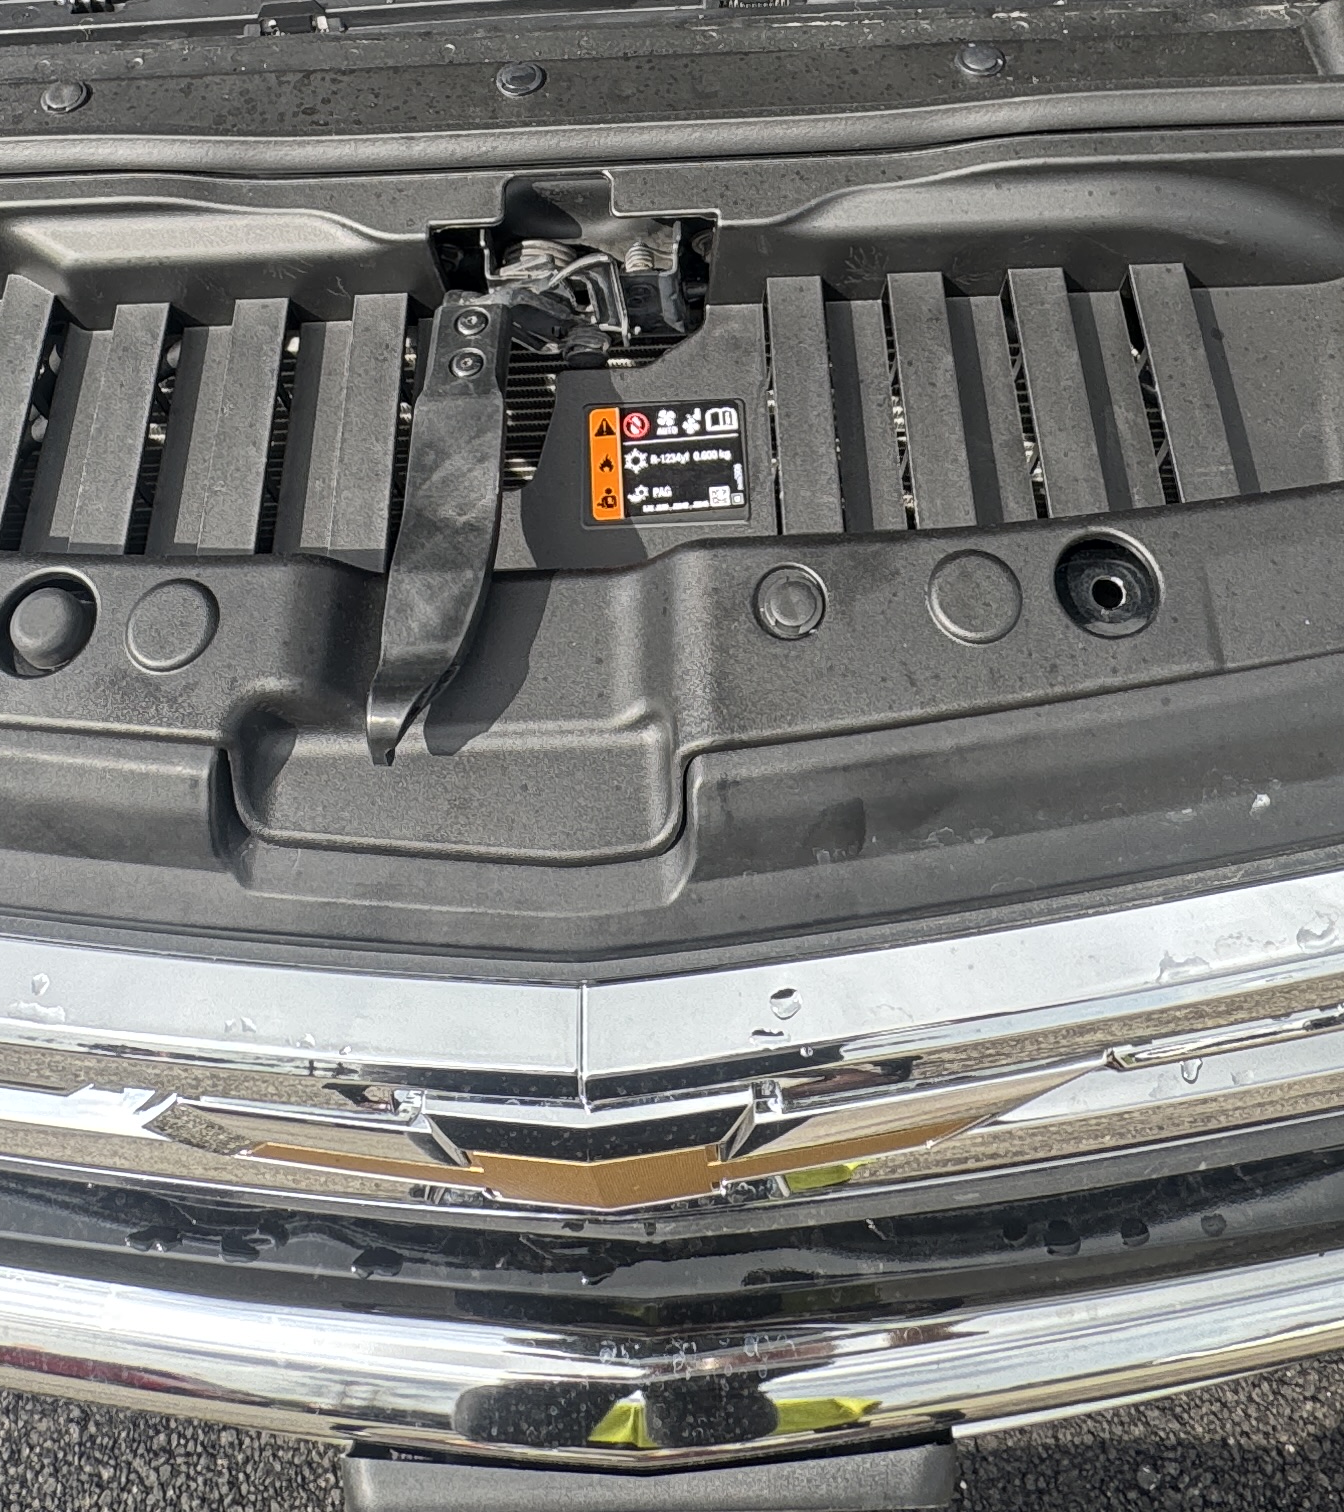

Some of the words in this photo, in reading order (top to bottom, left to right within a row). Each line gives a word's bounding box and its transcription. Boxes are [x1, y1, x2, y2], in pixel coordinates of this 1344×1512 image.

[650, 451, 690, 464] R-1234yf
[719, 449, 731, 461] kg
[652, 485, 672, 498] PAG
